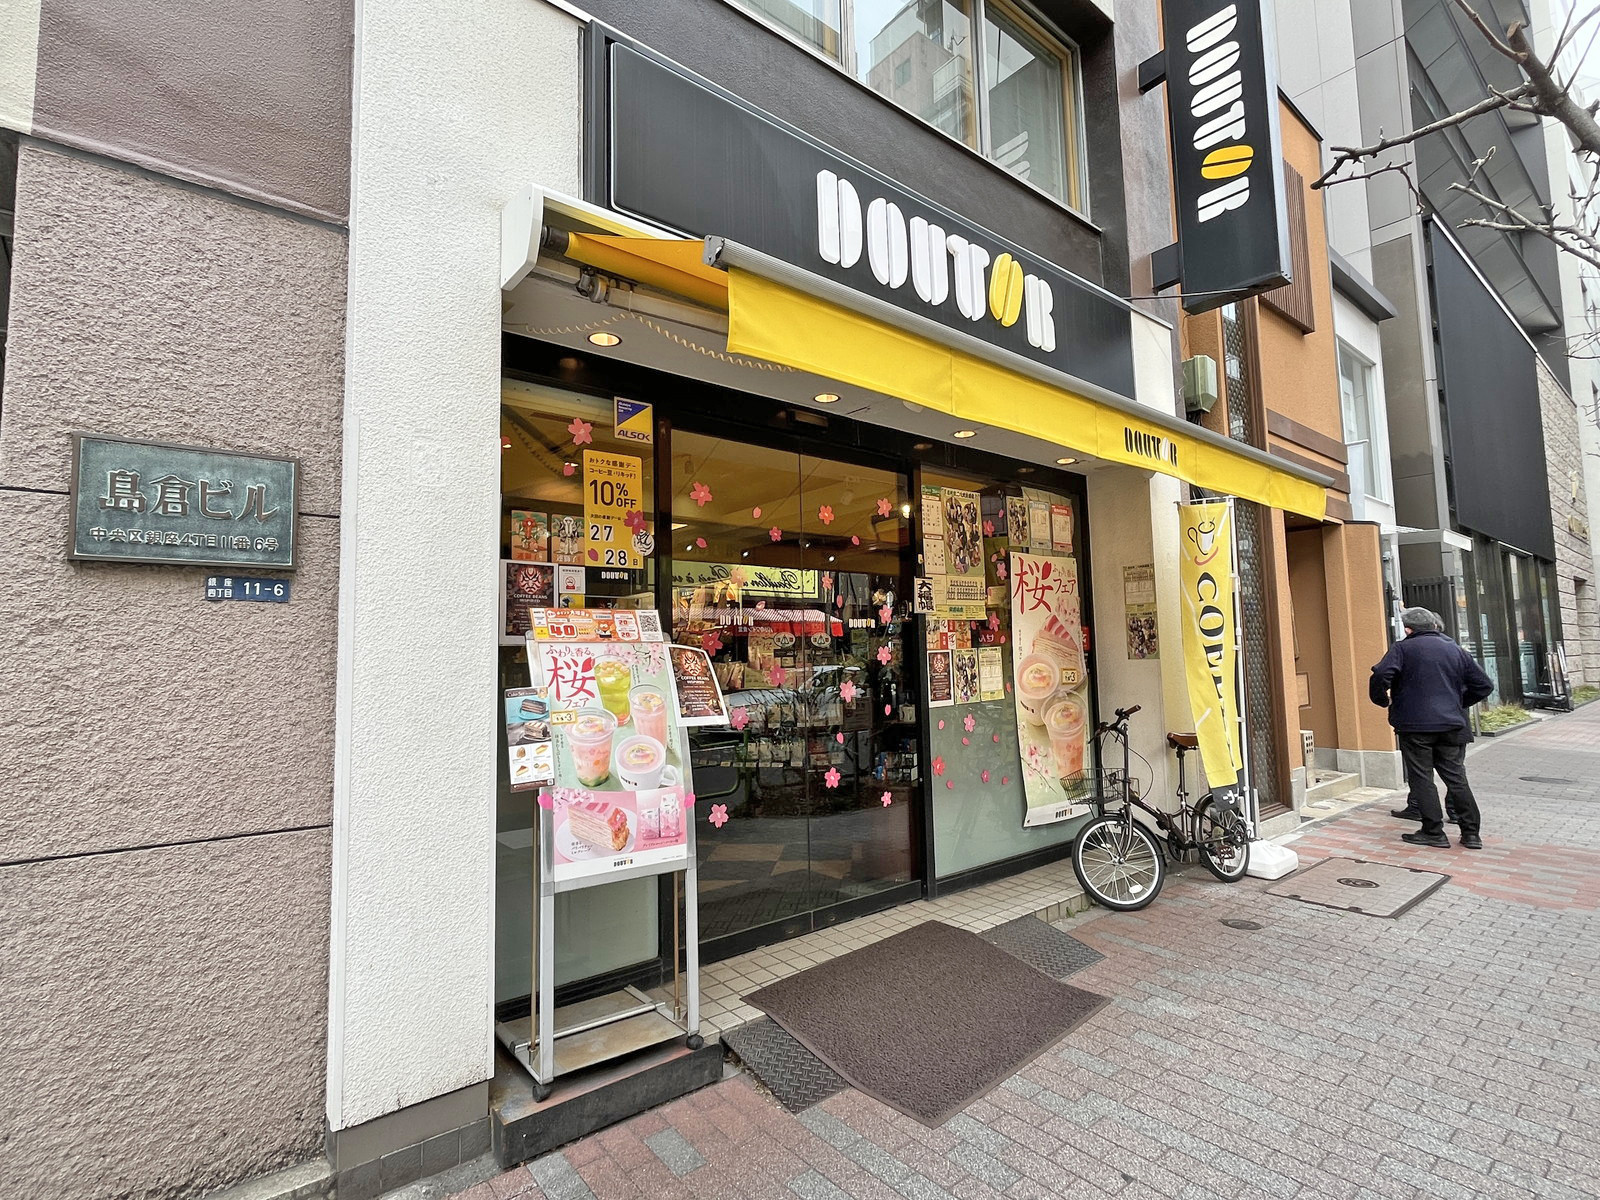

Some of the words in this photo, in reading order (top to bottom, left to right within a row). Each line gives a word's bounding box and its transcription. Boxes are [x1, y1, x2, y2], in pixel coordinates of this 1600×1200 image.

[1184, 3, 1254, 223] DOUTOR
[816, 168, 1057, 352] DOUTOR
[617, 429, 651, 442] ALSOK
[1124, 426, 1178, 468] DOUTOR
[99, 469, 281, 524] 島倉ビル
[615, 497, 637, 509] OFF
[590, 524, 613, 541] 27
[605, 549, 628, 566] 28
[207, 577, 233, 587] 銀座
[601, 571, 629, 580] DOUTOR
[207, 588, 233, 598] 四丁目
[242, 581, 285, 596] 11-6
[1012, 556, 1054, 615] 桜
[1052, 578, 1077, 596] フェア
[550, 624, 576, 636] 40
[848, 618, 876, 629] DOUTOR
[546, 656, 597, 702] 桜
[561, 697, 590, 710] フェア
